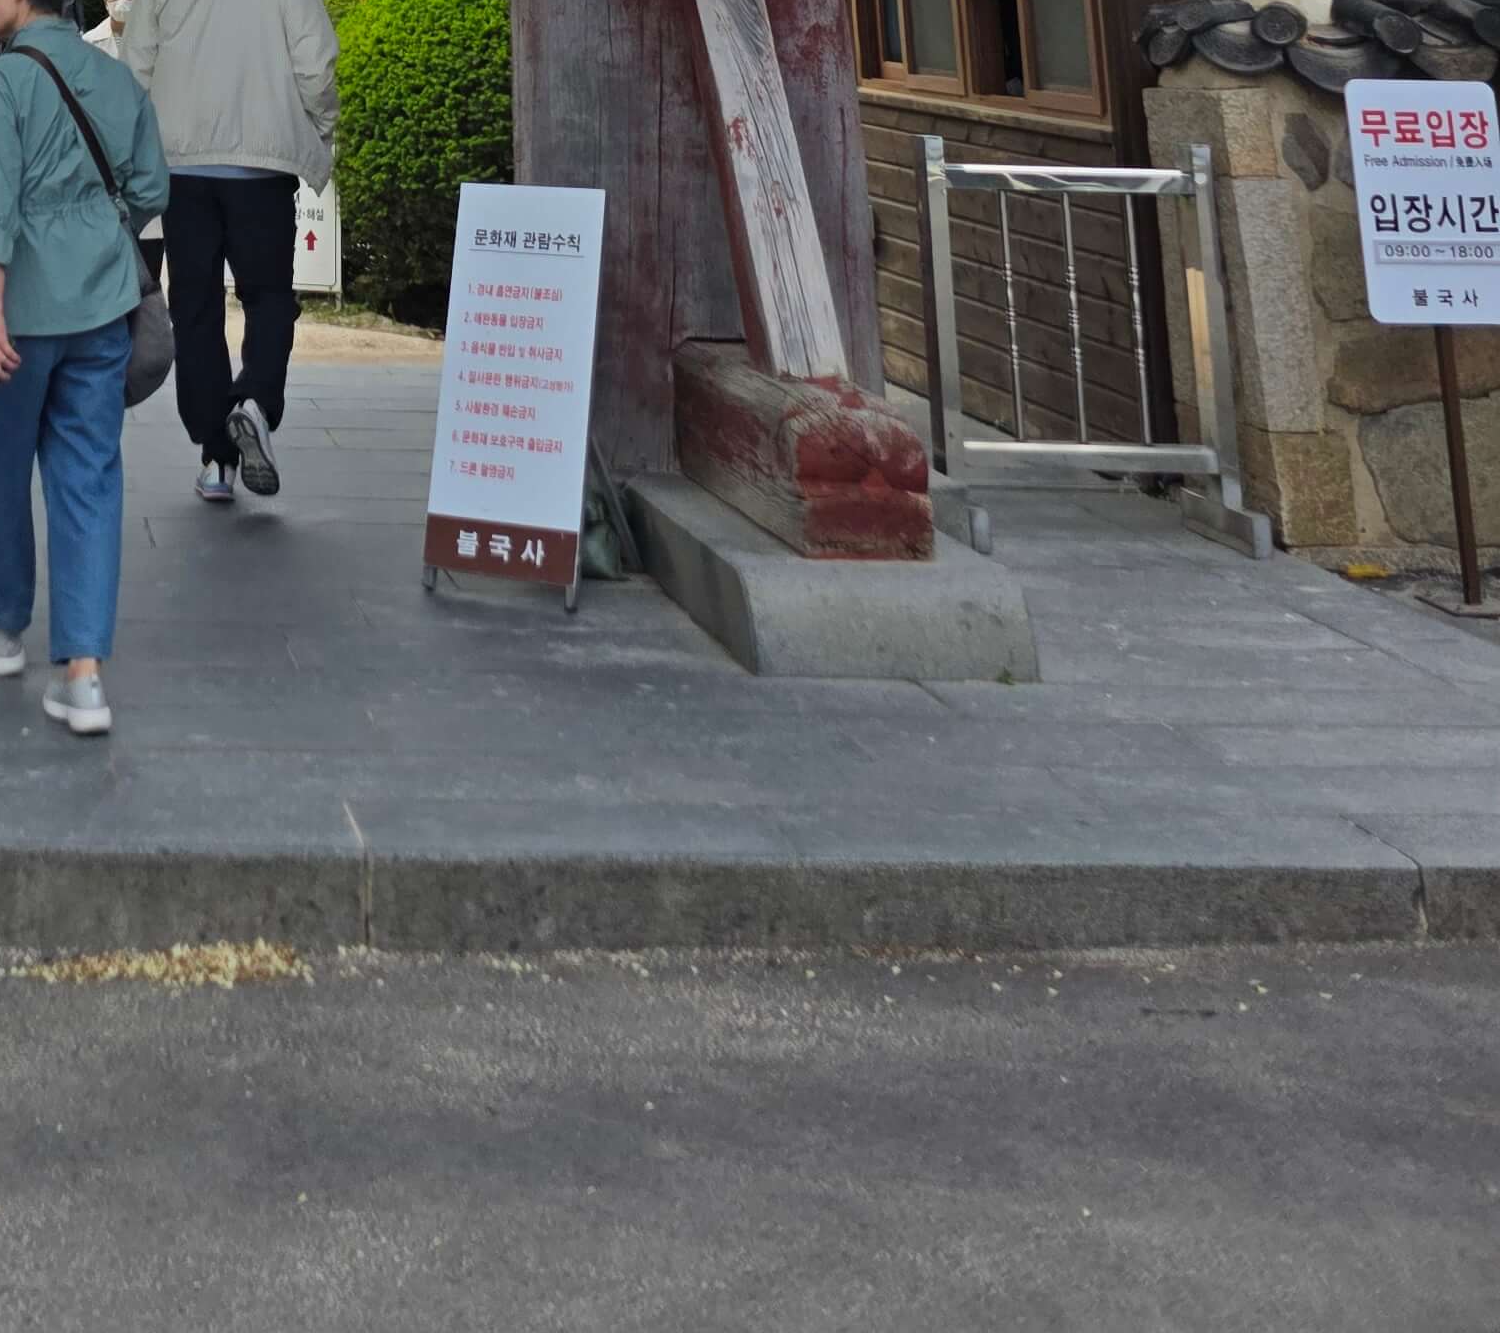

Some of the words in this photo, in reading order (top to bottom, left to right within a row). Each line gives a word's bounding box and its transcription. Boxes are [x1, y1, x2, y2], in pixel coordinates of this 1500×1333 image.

[1360, 109, 1489, 149] 무료입장
[1364, 154, 1388, 167] Free
[1392, 154, 1447, 168] Admission
[1370, 193, 1500, 233] 입장시간
[474, 228, 517, 249] 문화재
[522, 231, 581, 253] 관람수칙
[1385, 244, 1431, 257] 09:00
[1450, 245, 1495, 259] 18:00
[477, 284, 493, 296] 경내
[1412, 288, 1479, 308] 불국사
[474, 313, 507, 327] 애완동물
[510, 314, 544, 330] 입장금지
[471, 341, 496, 356] 음식물
[499, 343, 516, 358] 반입
[529, 345, 563, 362] 취사금지
[465, 400, 500, 416] 사찰환경
[462, 430, 488, 445] 문화재
[490, 434, 525, 450] 보호구역
[527, 437, 563, 453] 출입금지
[460, 461, 477, 476] 드론
[456, 529, 546, 568] 불국사
